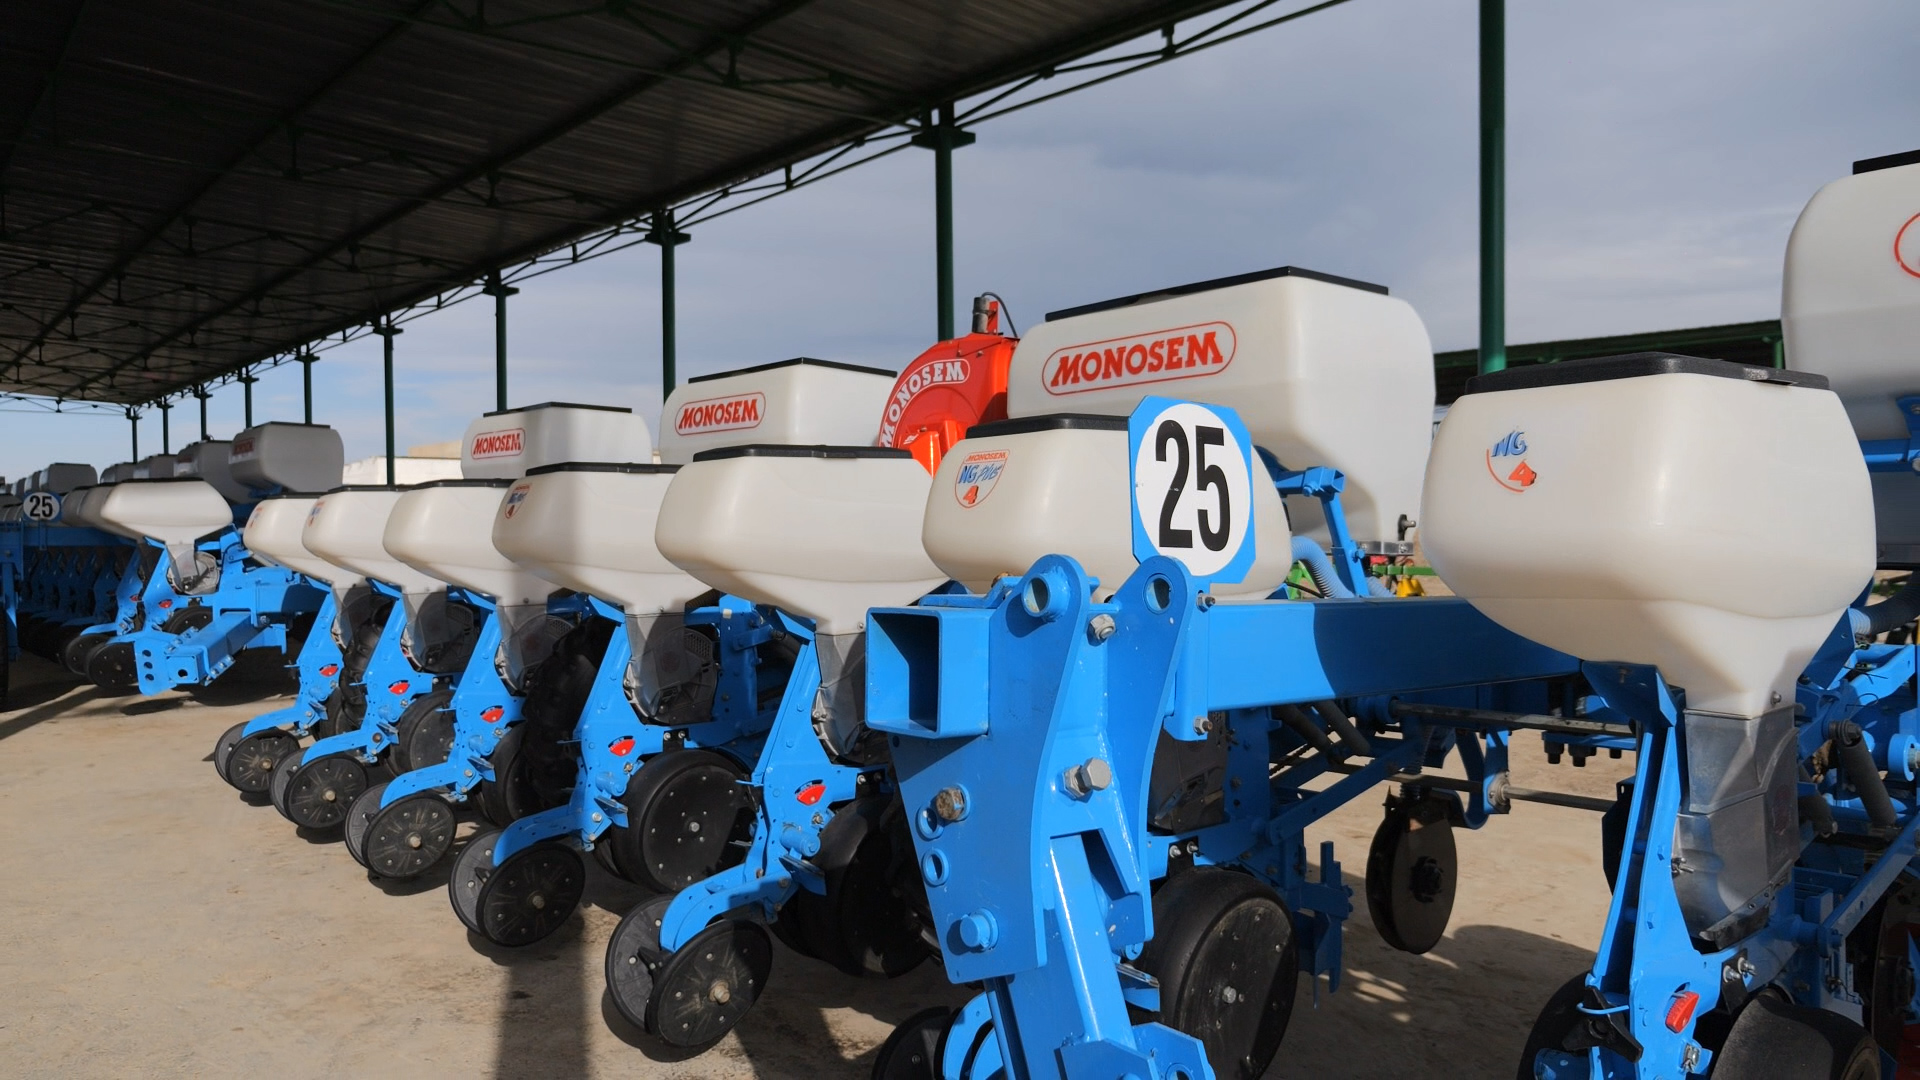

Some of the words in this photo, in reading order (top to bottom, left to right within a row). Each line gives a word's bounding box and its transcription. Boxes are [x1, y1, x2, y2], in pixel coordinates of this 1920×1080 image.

[1050, 331, 1224, 387] MONOSEM
[678, 399, 759, 430] MONOSEM
[881, 361, 965, 448] MONOSEM
[473, 433, 522, 455] MONOSEM
[1491, 430, 1528, 457] NG
[958, 464, 979, 484] NG
[1155, 419, 1231, 552] 25
[29, 495, 53, 518] 25
[962, 485, 979, 505] 4
